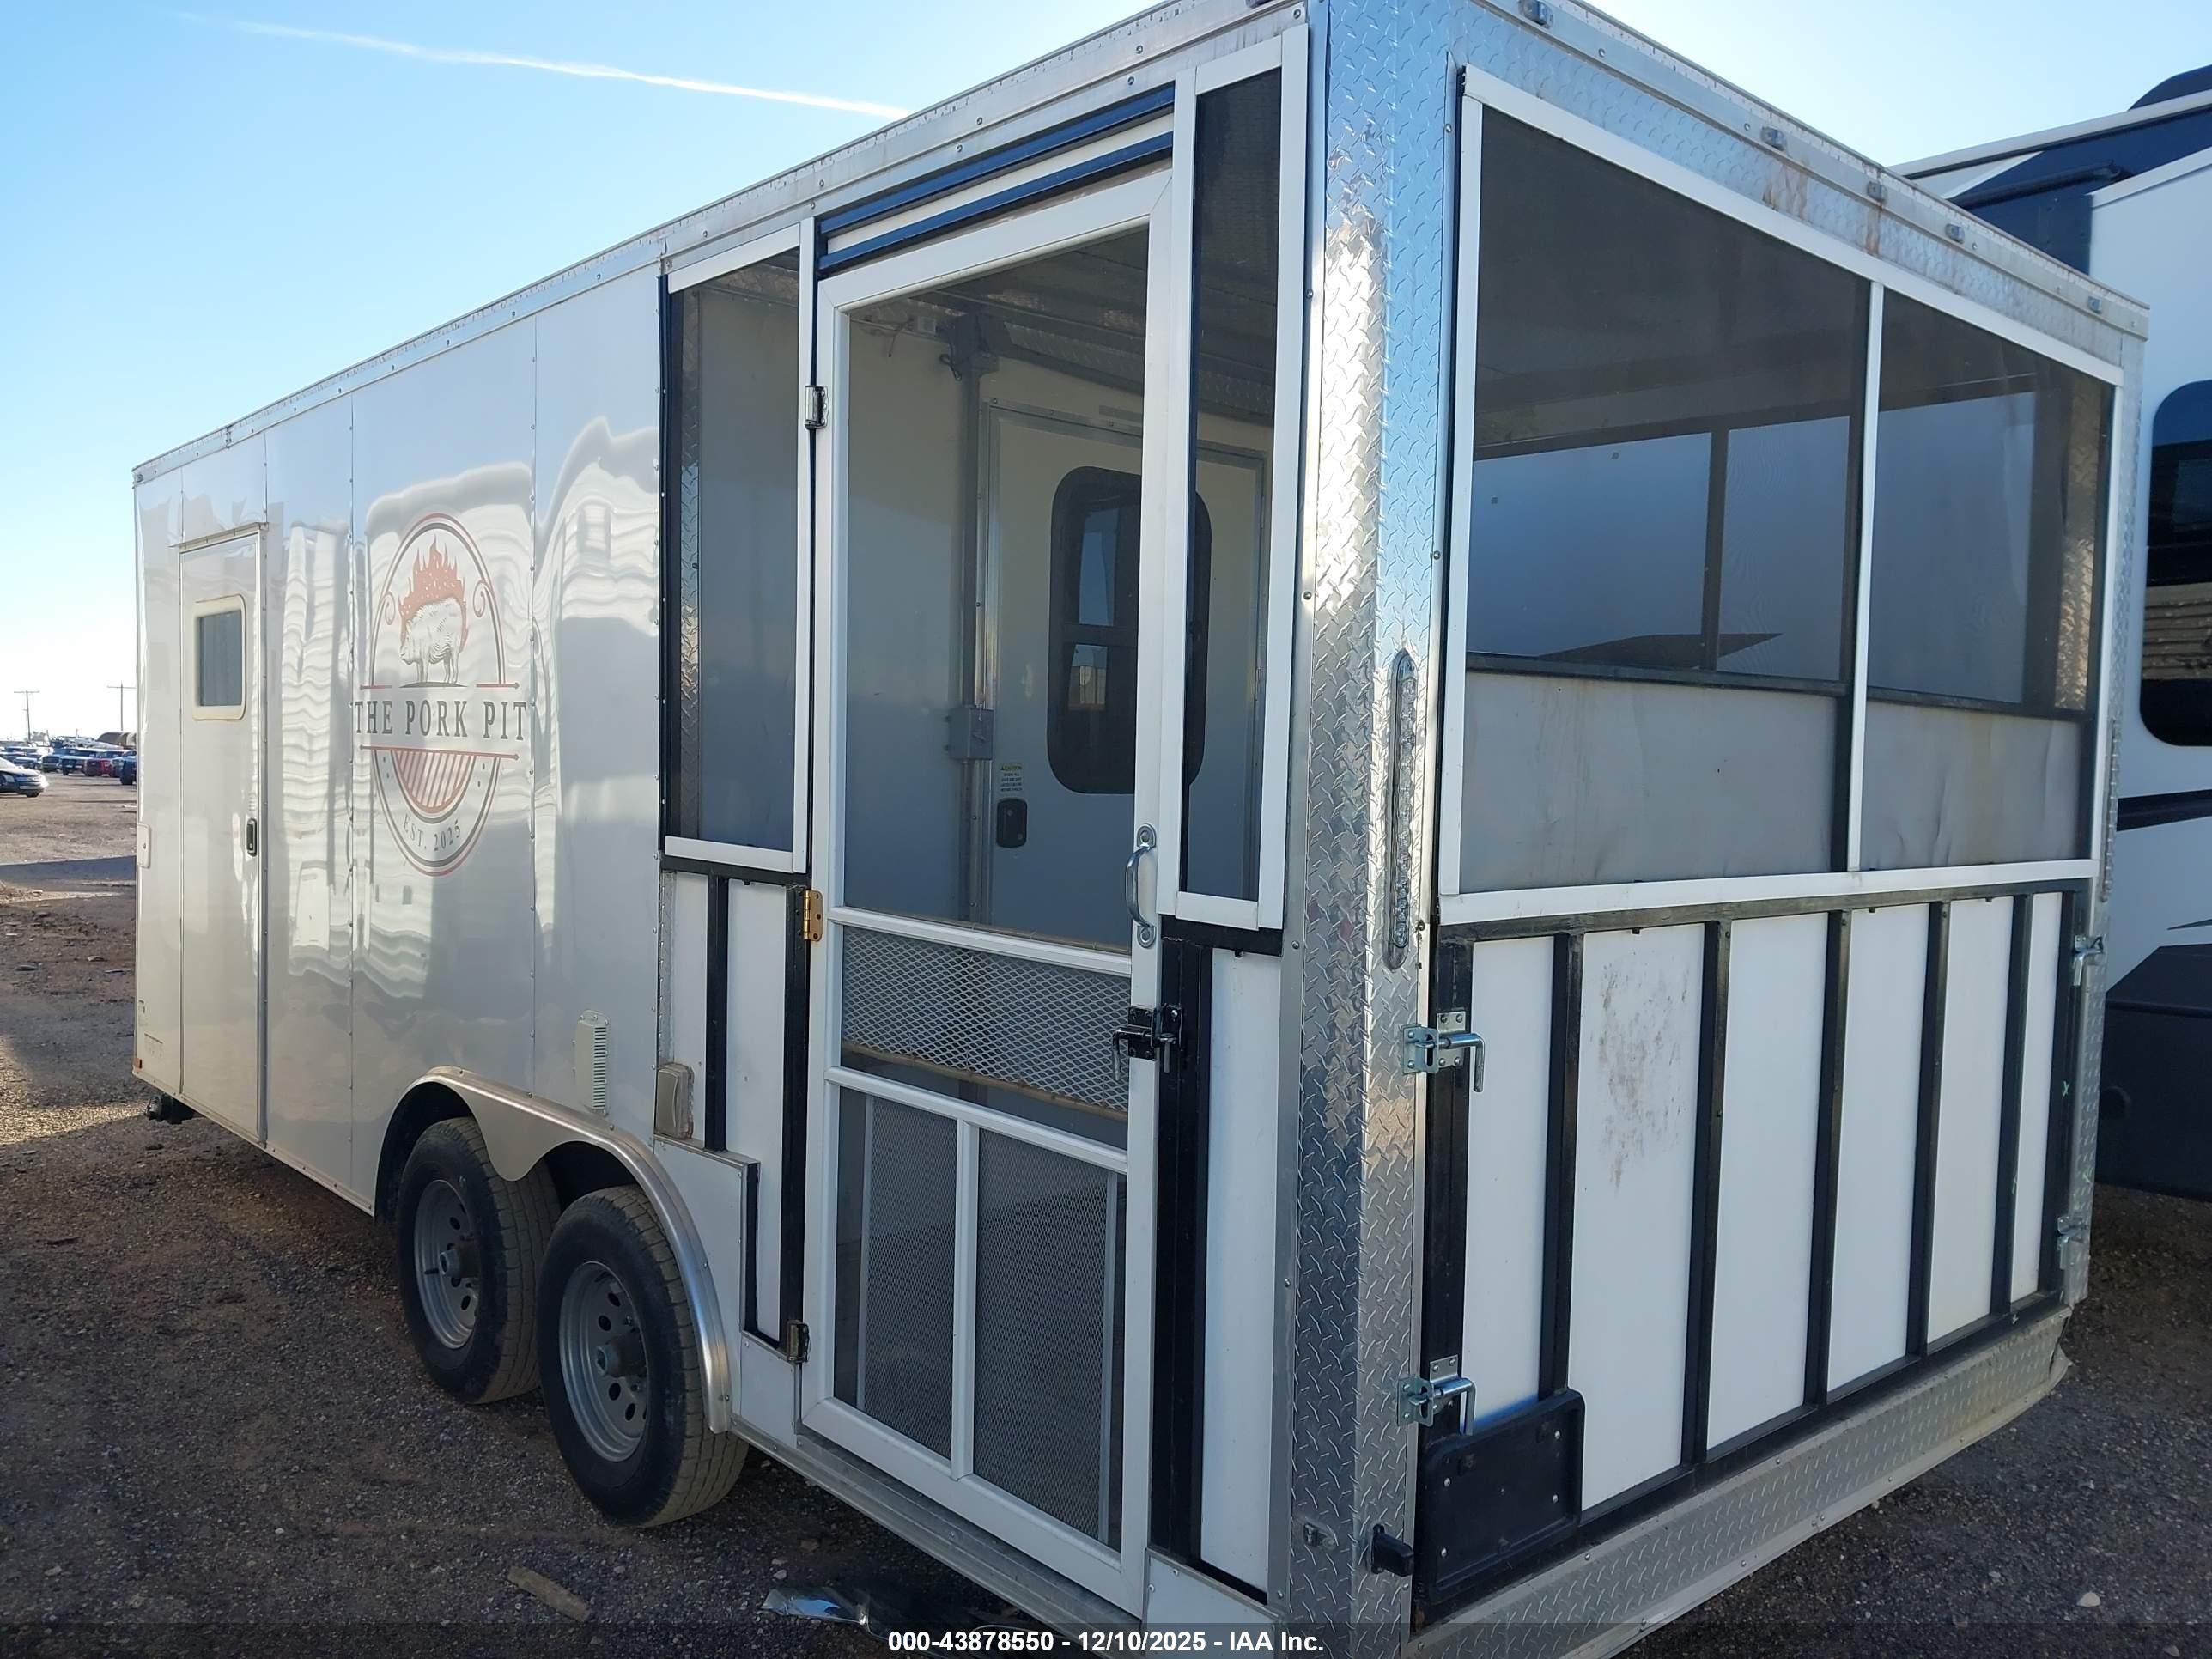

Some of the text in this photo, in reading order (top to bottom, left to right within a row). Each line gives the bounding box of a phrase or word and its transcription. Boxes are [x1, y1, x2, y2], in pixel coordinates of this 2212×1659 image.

[355, 700, 526, 740] THE PORK PIT
[404, 813, 460, 851] EST. 2025
